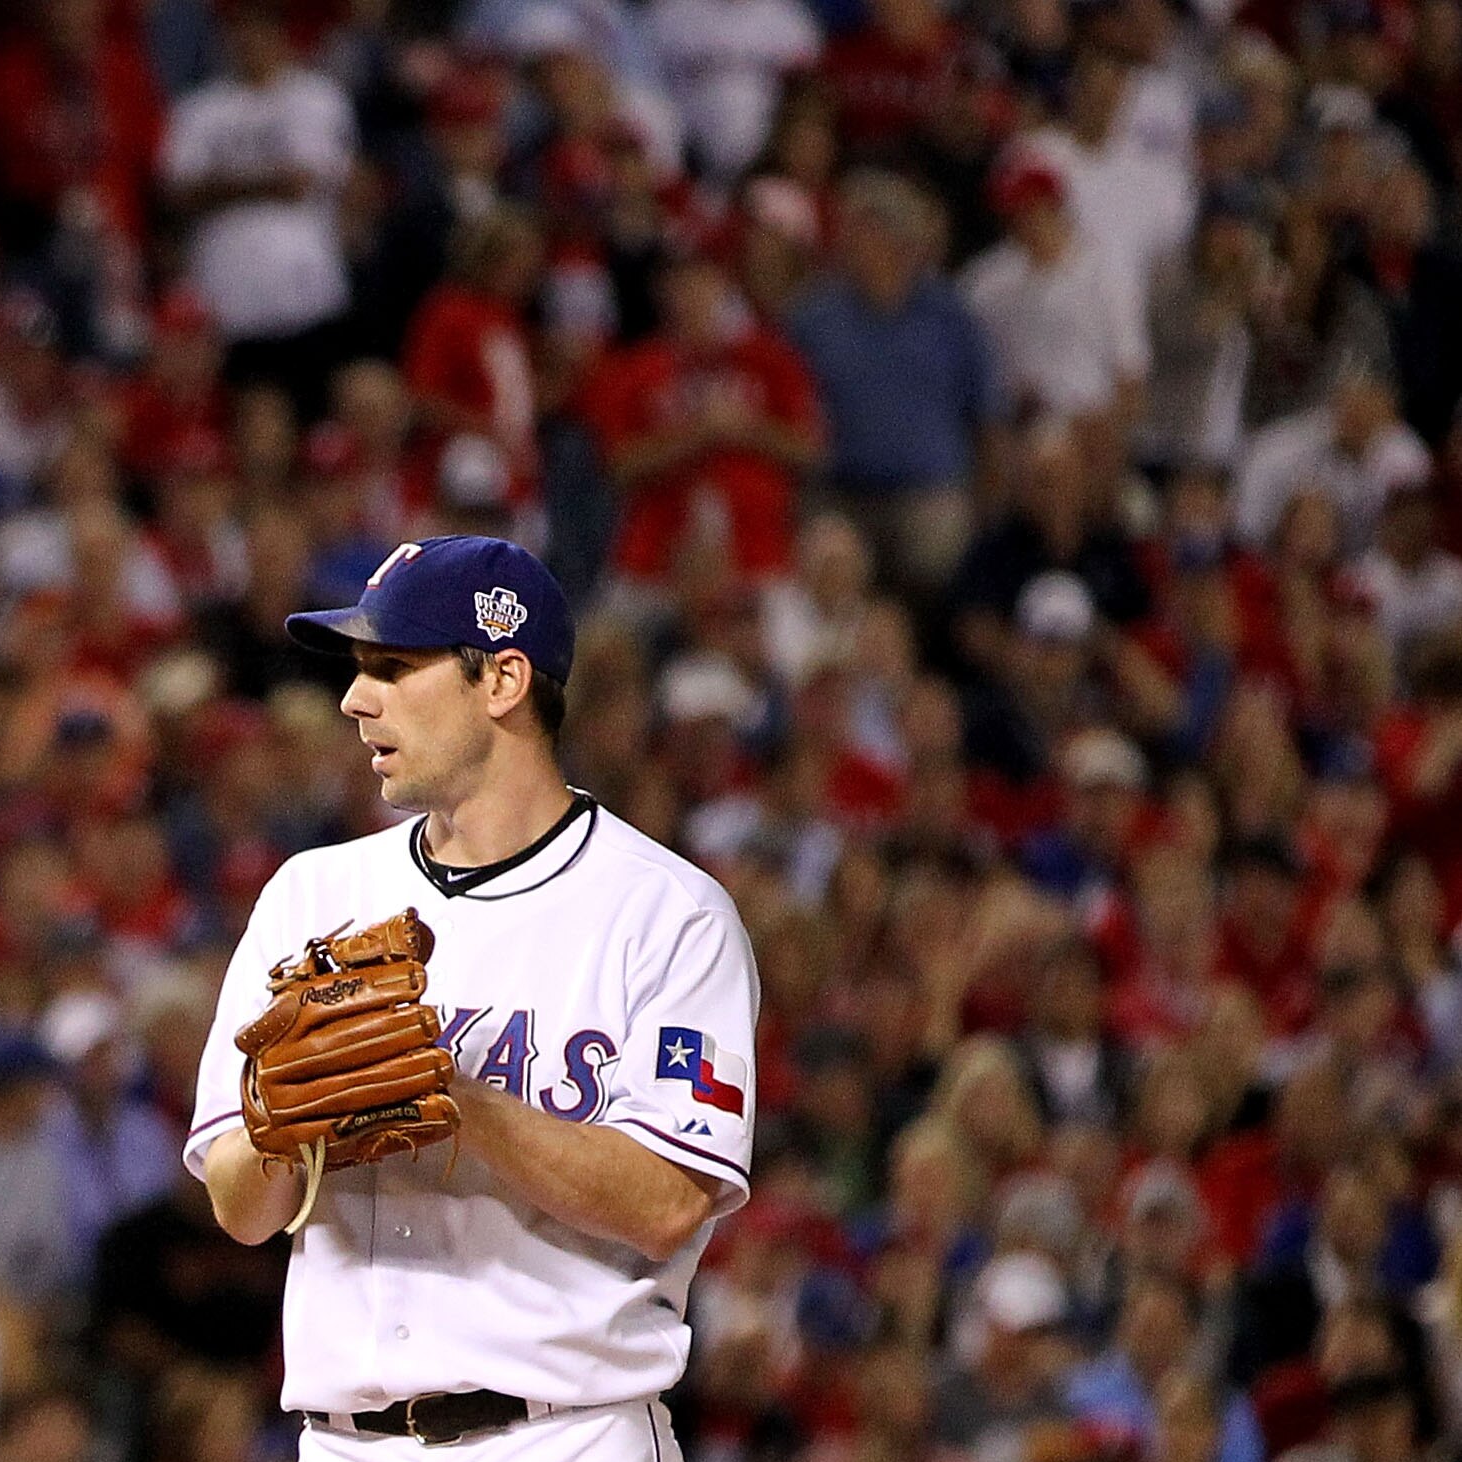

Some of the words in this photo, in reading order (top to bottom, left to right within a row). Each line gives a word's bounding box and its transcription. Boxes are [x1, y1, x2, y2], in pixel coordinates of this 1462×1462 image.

[367, 542, 423, 588] T
[477, 594, 526, 621] WORLD
[479, 609, 516, 628] SERIES
[300, 977, 363, 1006] Rawlings
[430, 1003, 621, 1124] XAS
